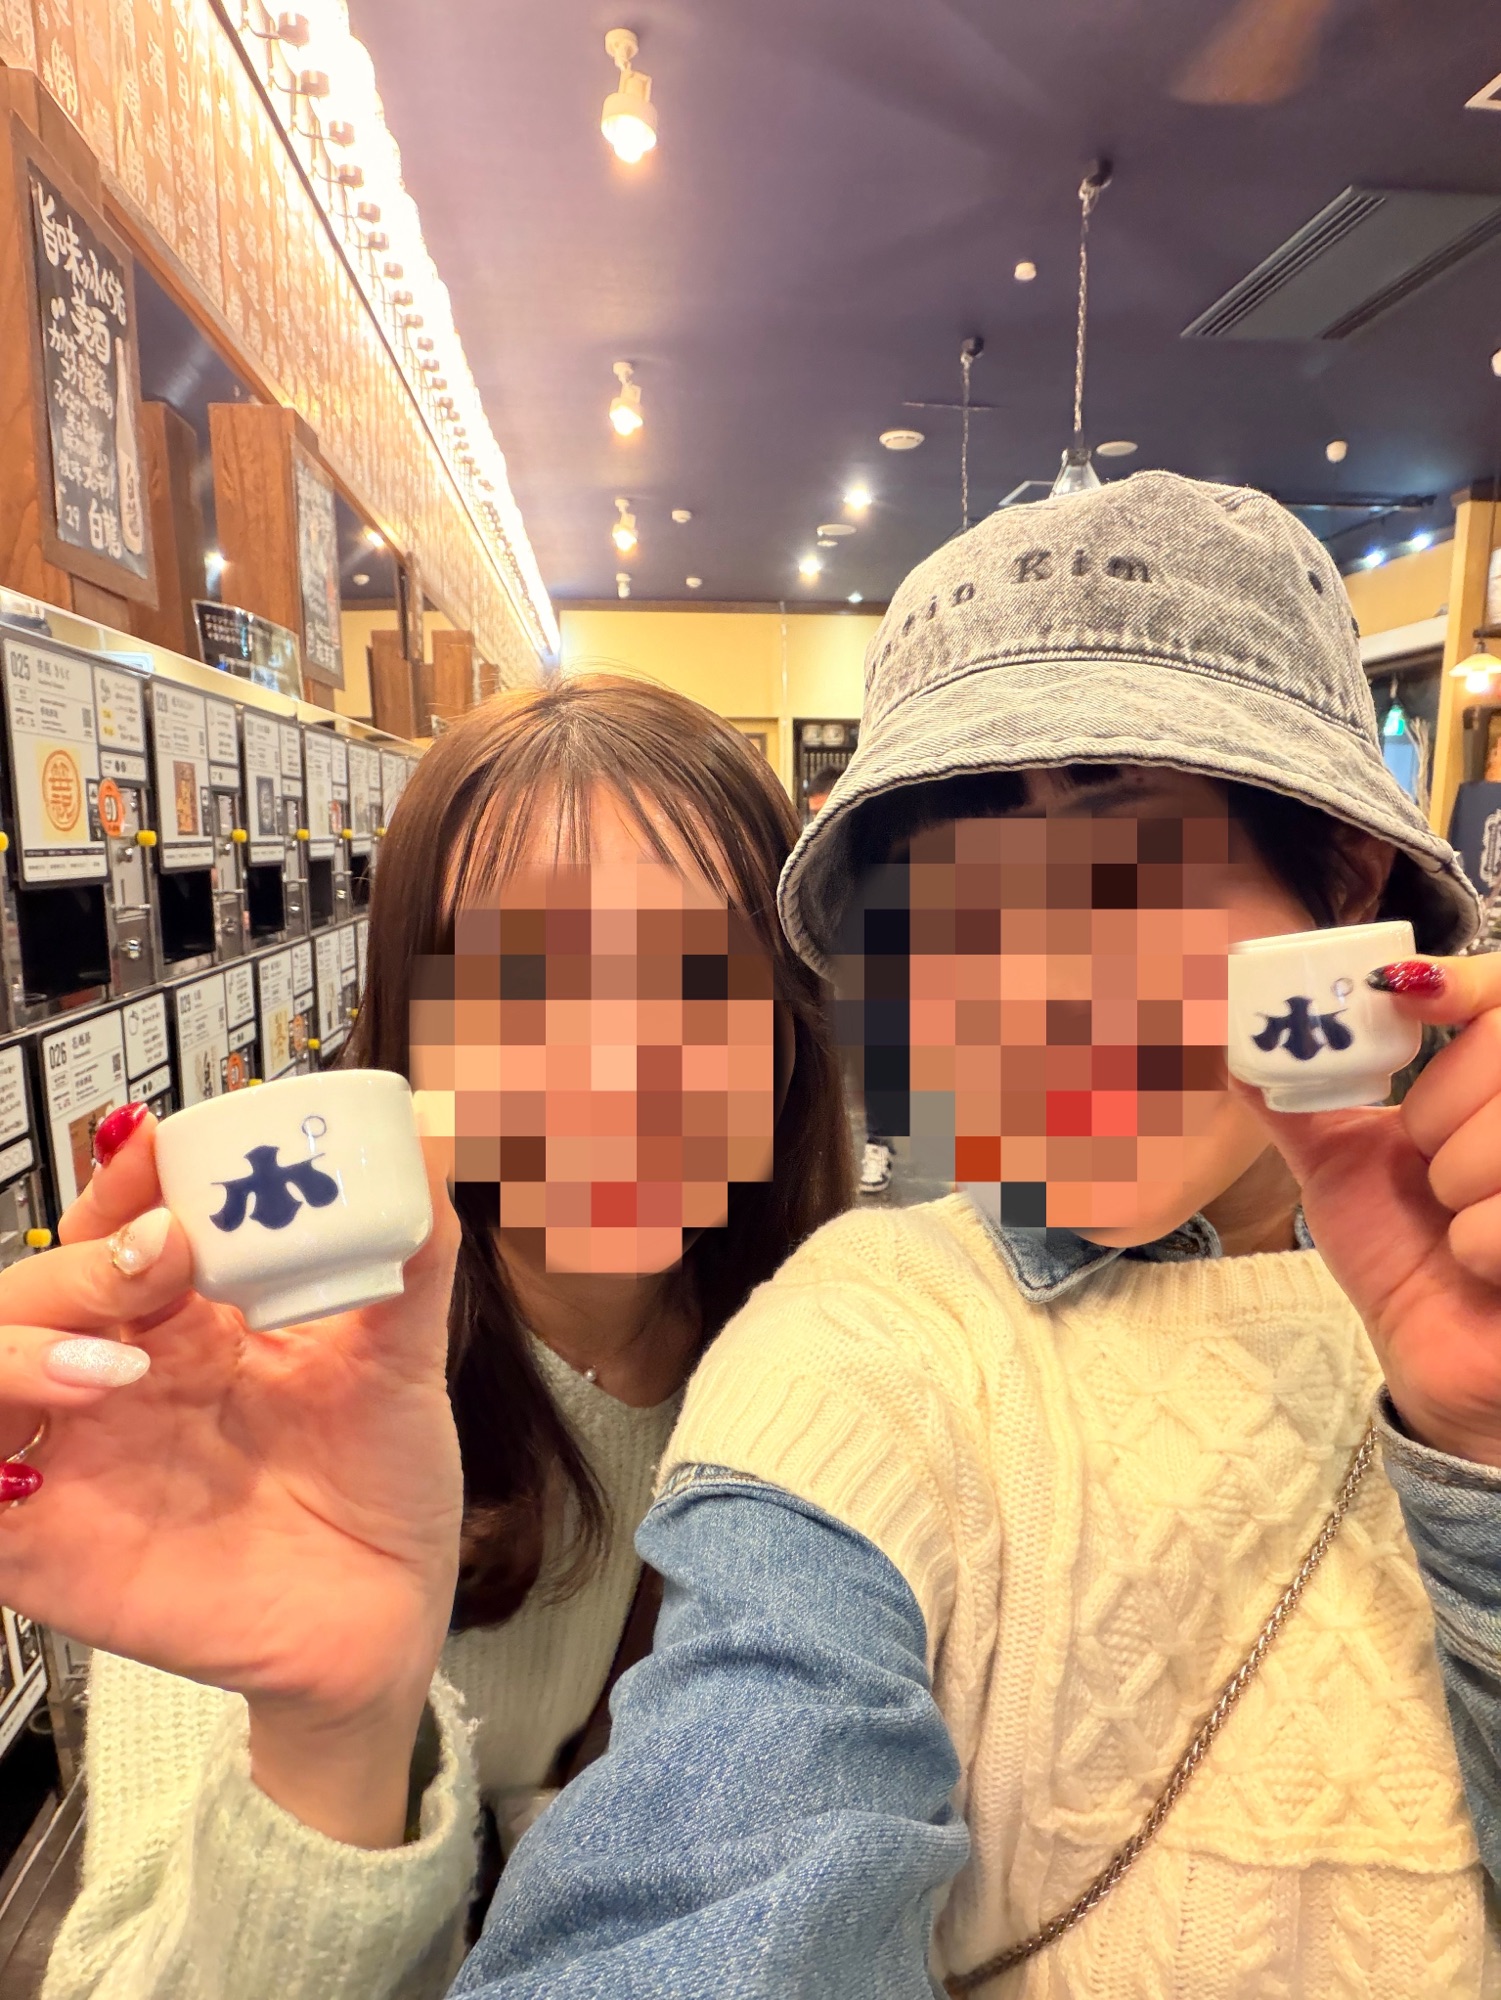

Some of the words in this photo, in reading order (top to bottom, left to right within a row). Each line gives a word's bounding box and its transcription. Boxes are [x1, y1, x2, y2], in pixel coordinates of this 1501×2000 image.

[1010, 548, 1153, 585] Kim
[10, 651, 31, 681] 025
[50, 1041, 67, 1070] 026
